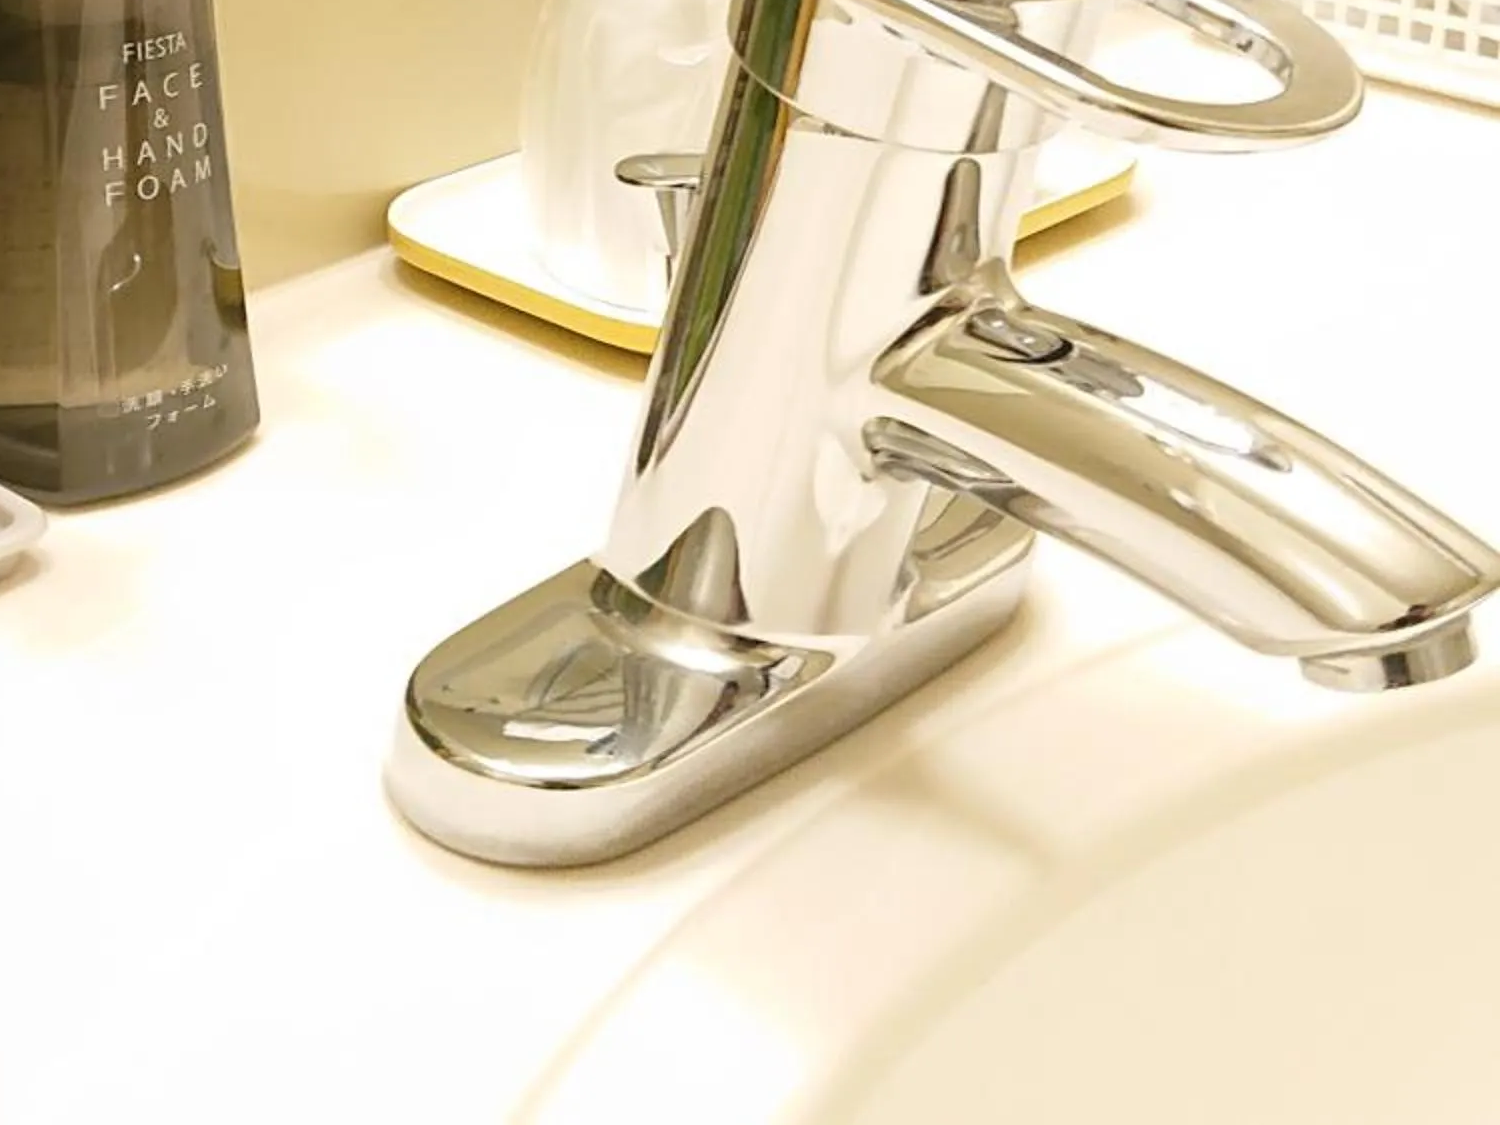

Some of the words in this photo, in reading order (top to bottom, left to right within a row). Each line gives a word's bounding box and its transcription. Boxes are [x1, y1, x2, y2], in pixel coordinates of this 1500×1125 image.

[122, 31, 187, 63] FIESTA
[98, 63, 203, 111] FACE
[153, 109, 170, 129] &
[102, 122, 208, 172] HAND
[104, 155, 211, 208] FOAM
